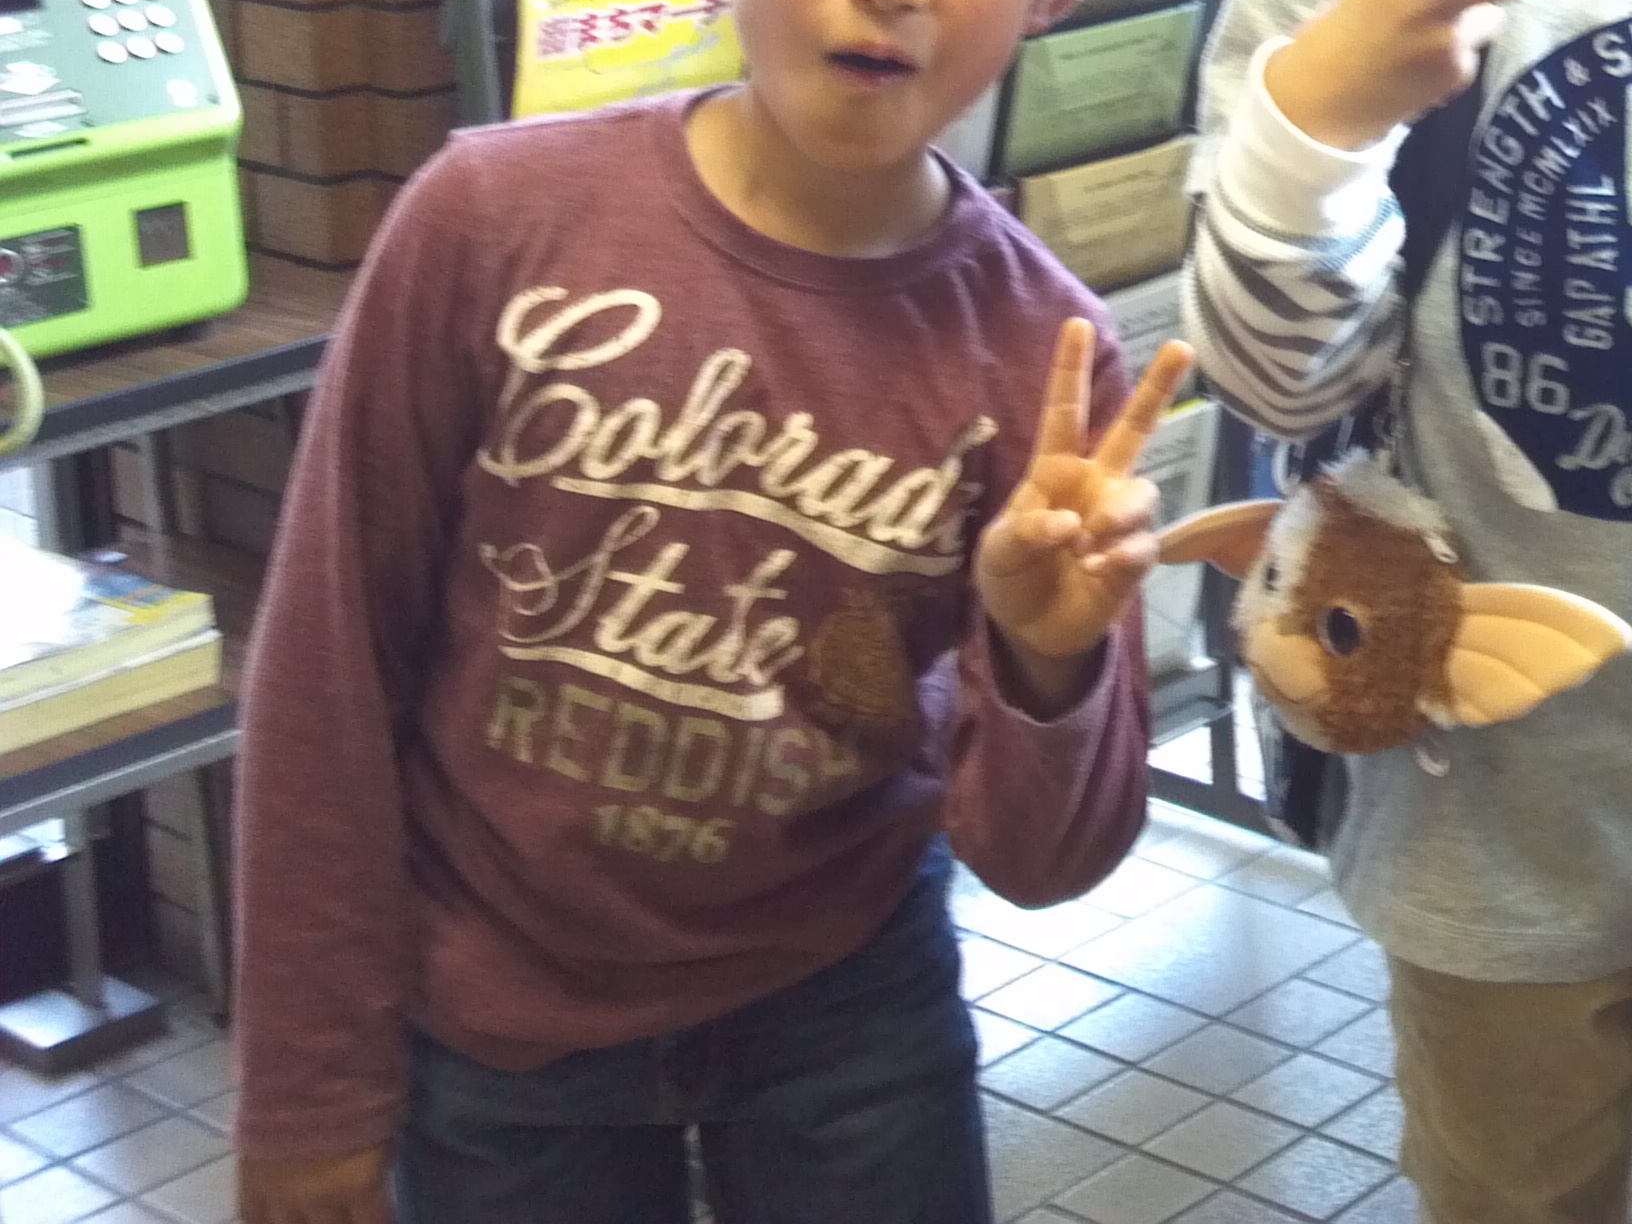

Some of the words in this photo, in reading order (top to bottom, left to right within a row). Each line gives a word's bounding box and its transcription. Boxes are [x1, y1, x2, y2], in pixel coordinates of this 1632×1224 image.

[1461, 69, 1567, 327] STRENGTH
[1561, 277, 1616, 351] GAP
[1482, 342, 1571, 415] 86
[479, 505, 807, 688] State
